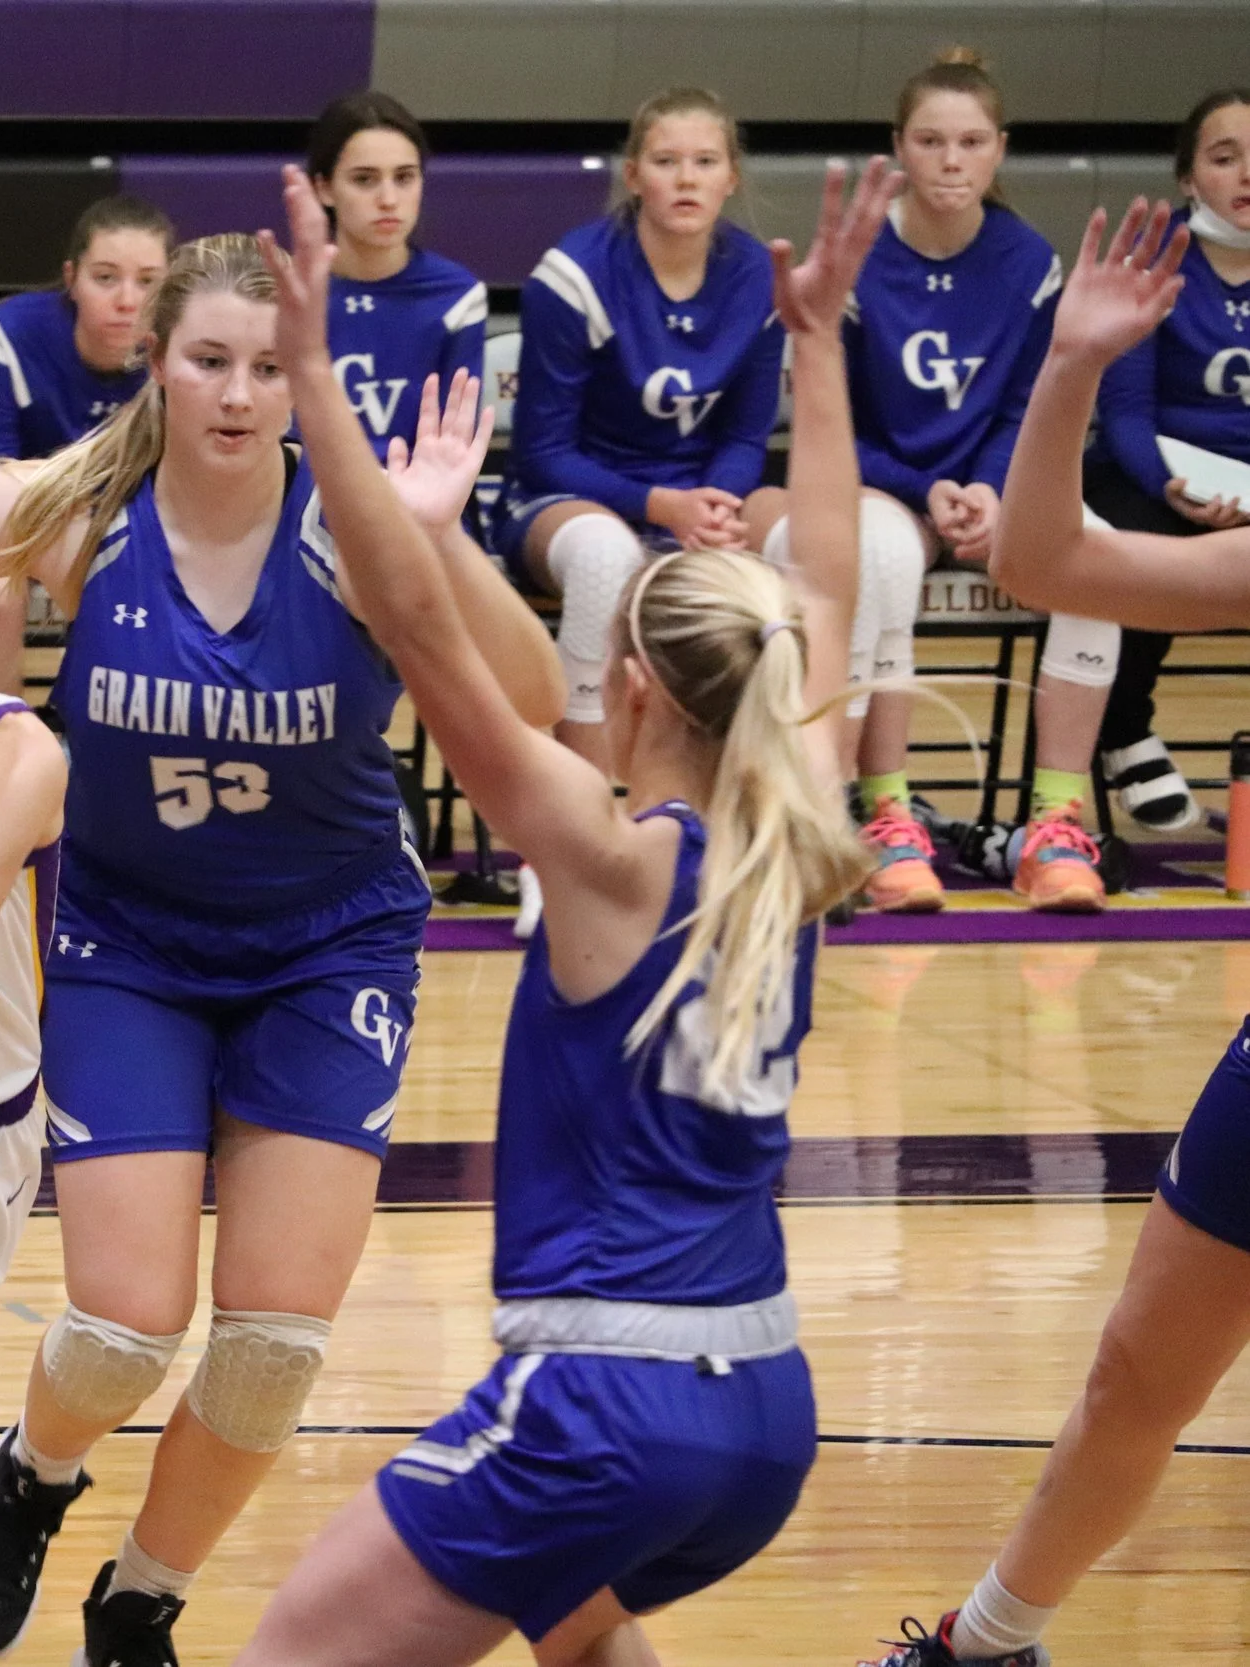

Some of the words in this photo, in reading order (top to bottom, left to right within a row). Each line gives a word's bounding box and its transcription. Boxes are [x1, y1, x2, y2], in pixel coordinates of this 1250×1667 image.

[642, 366, 723, 438] GV
[901, 330, 986, 411] GV
[1204, 346, 1250, 406] G
[88, 665, 192, 736] GRAIN
[202, 682, 336, 745] VALLEY
[149, 755, 272, 831] 53
[351, 987, 403, 1067] GV
